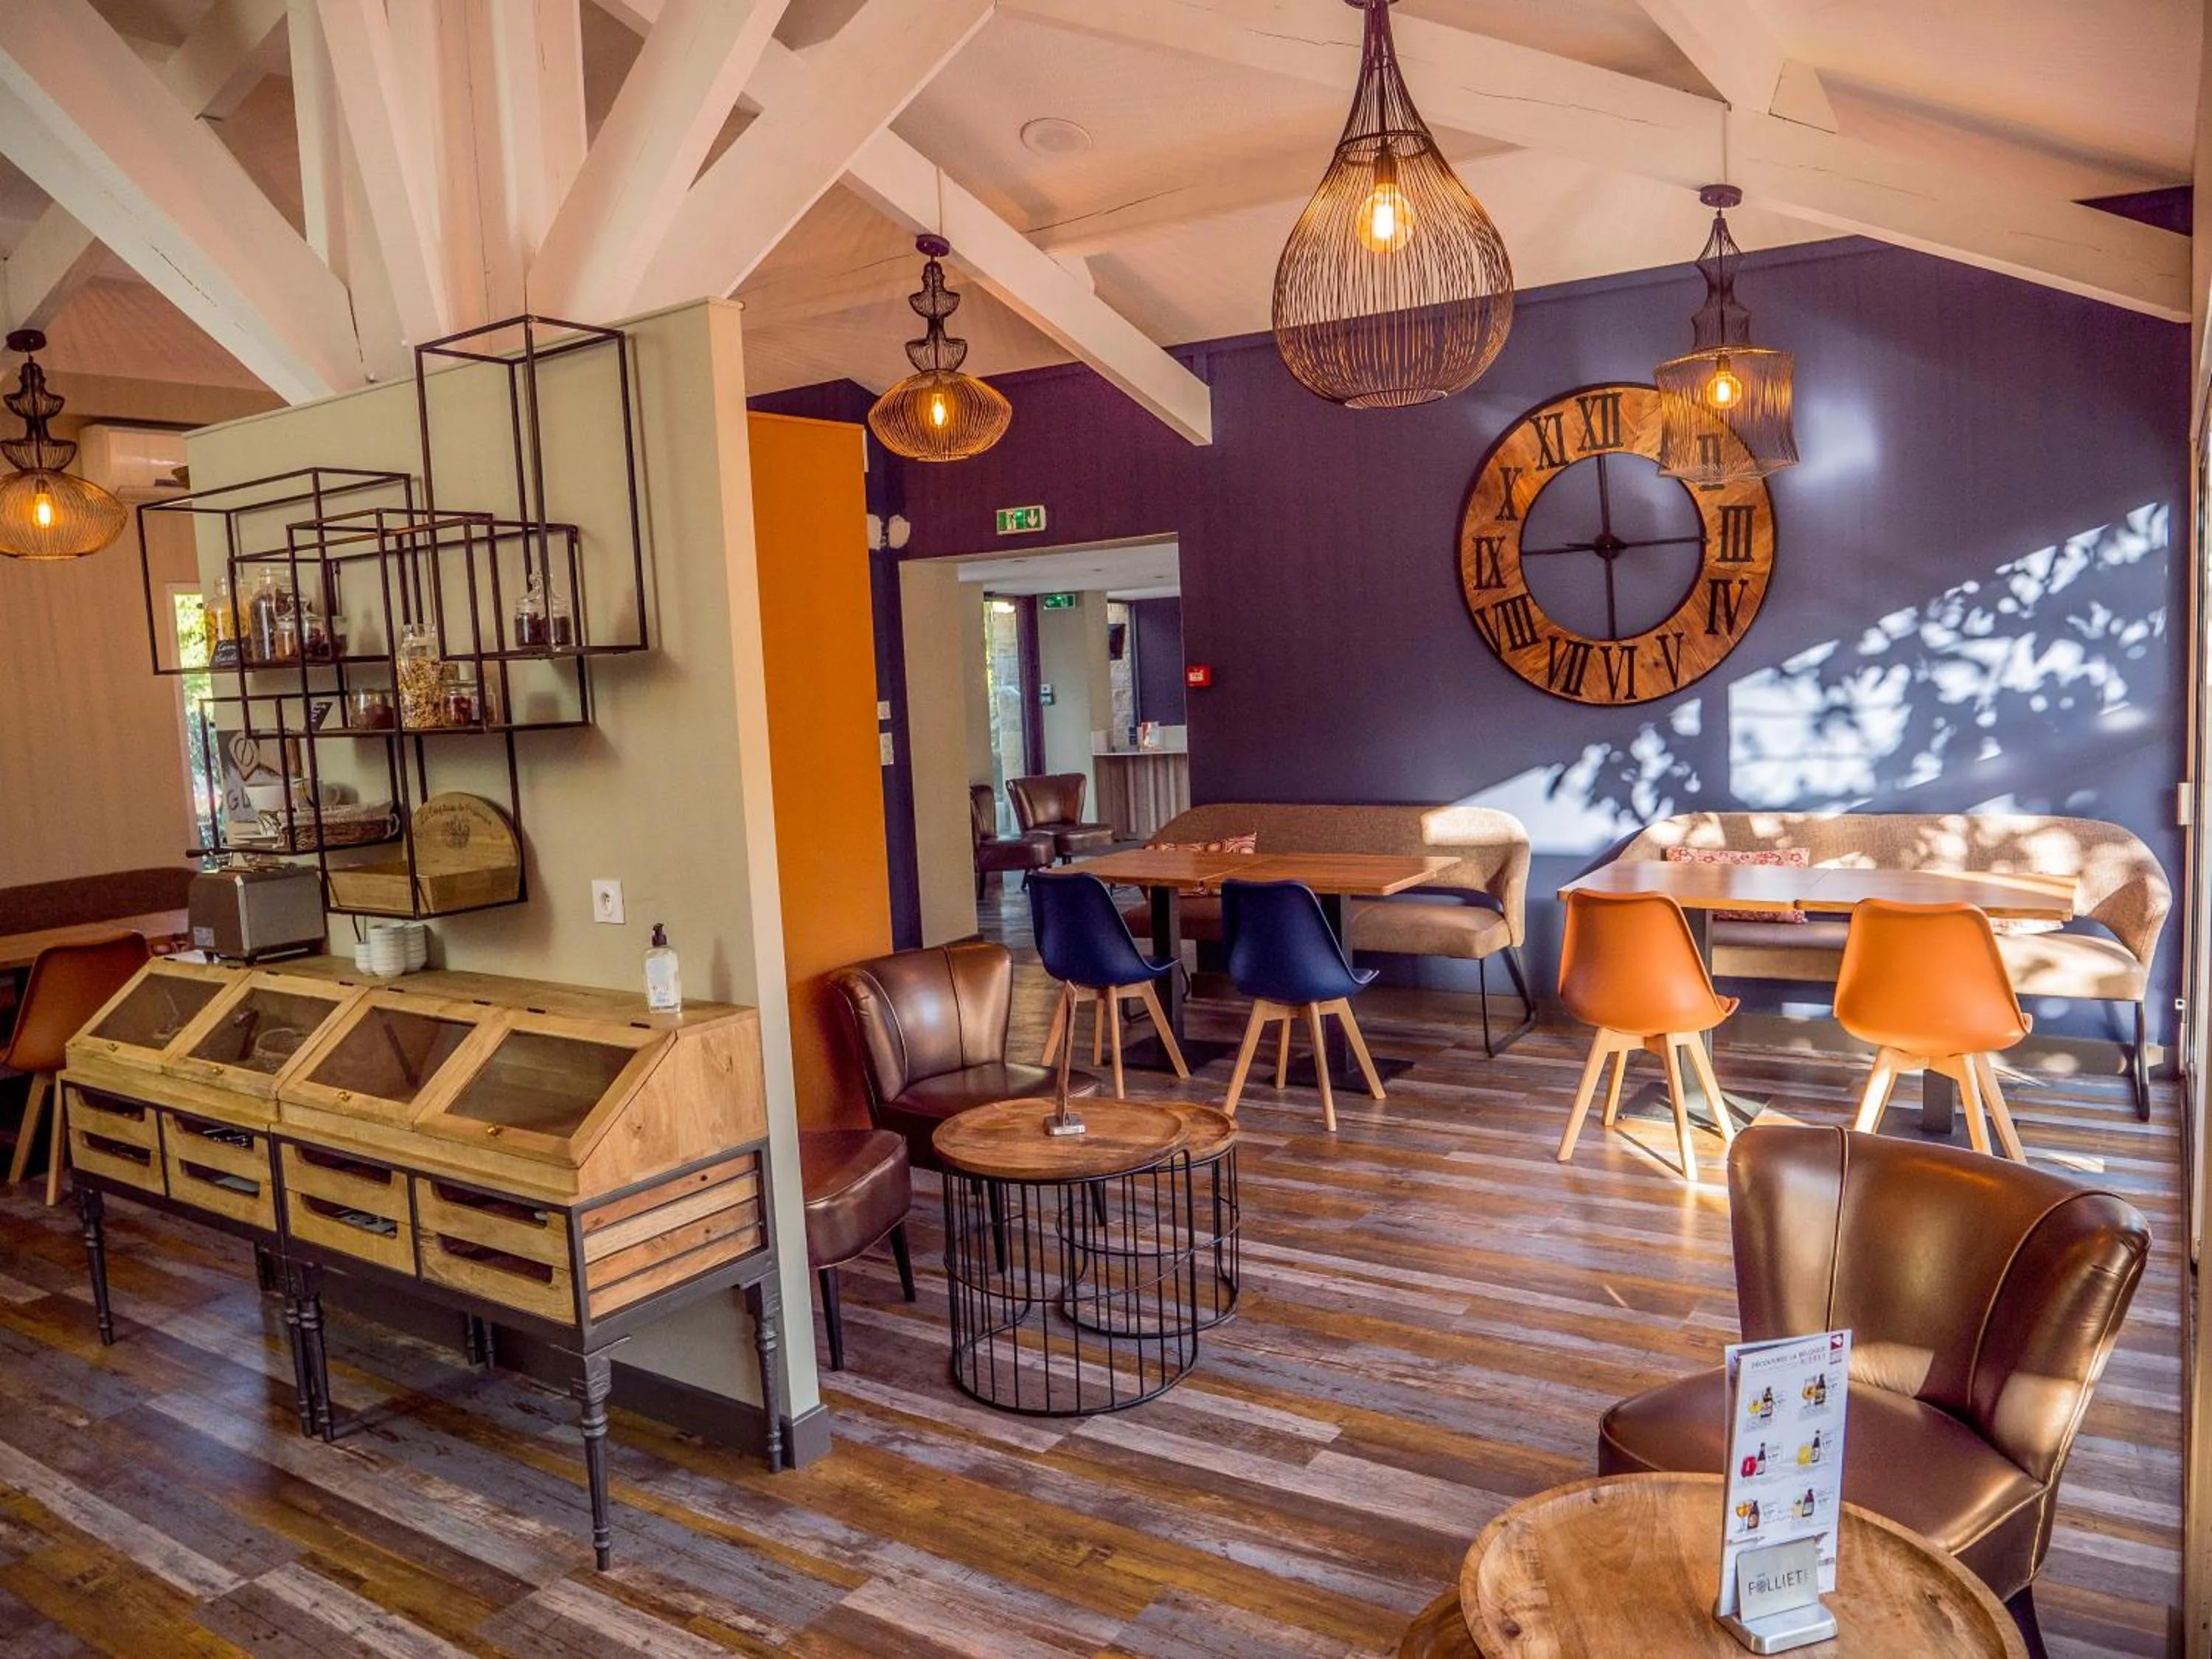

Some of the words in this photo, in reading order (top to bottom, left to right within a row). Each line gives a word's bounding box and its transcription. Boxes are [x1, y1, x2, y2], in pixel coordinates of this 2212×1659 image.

[1531, 411, 1570, 472] XI
[1576, 392, 1624, 451] XII
[1495, 467, 1523, 521] X
[1472, 536, 1507, 590] IX
[1715, 505, 1757, 563] III
[1475, 593, 1541, 658] VIII
[1705, 578, 1748, 636] IV
[1548, 635, 1594, 697] VII
[1599, 644, 1638, 700] VI
[1655, 632, 1685, 689] V
